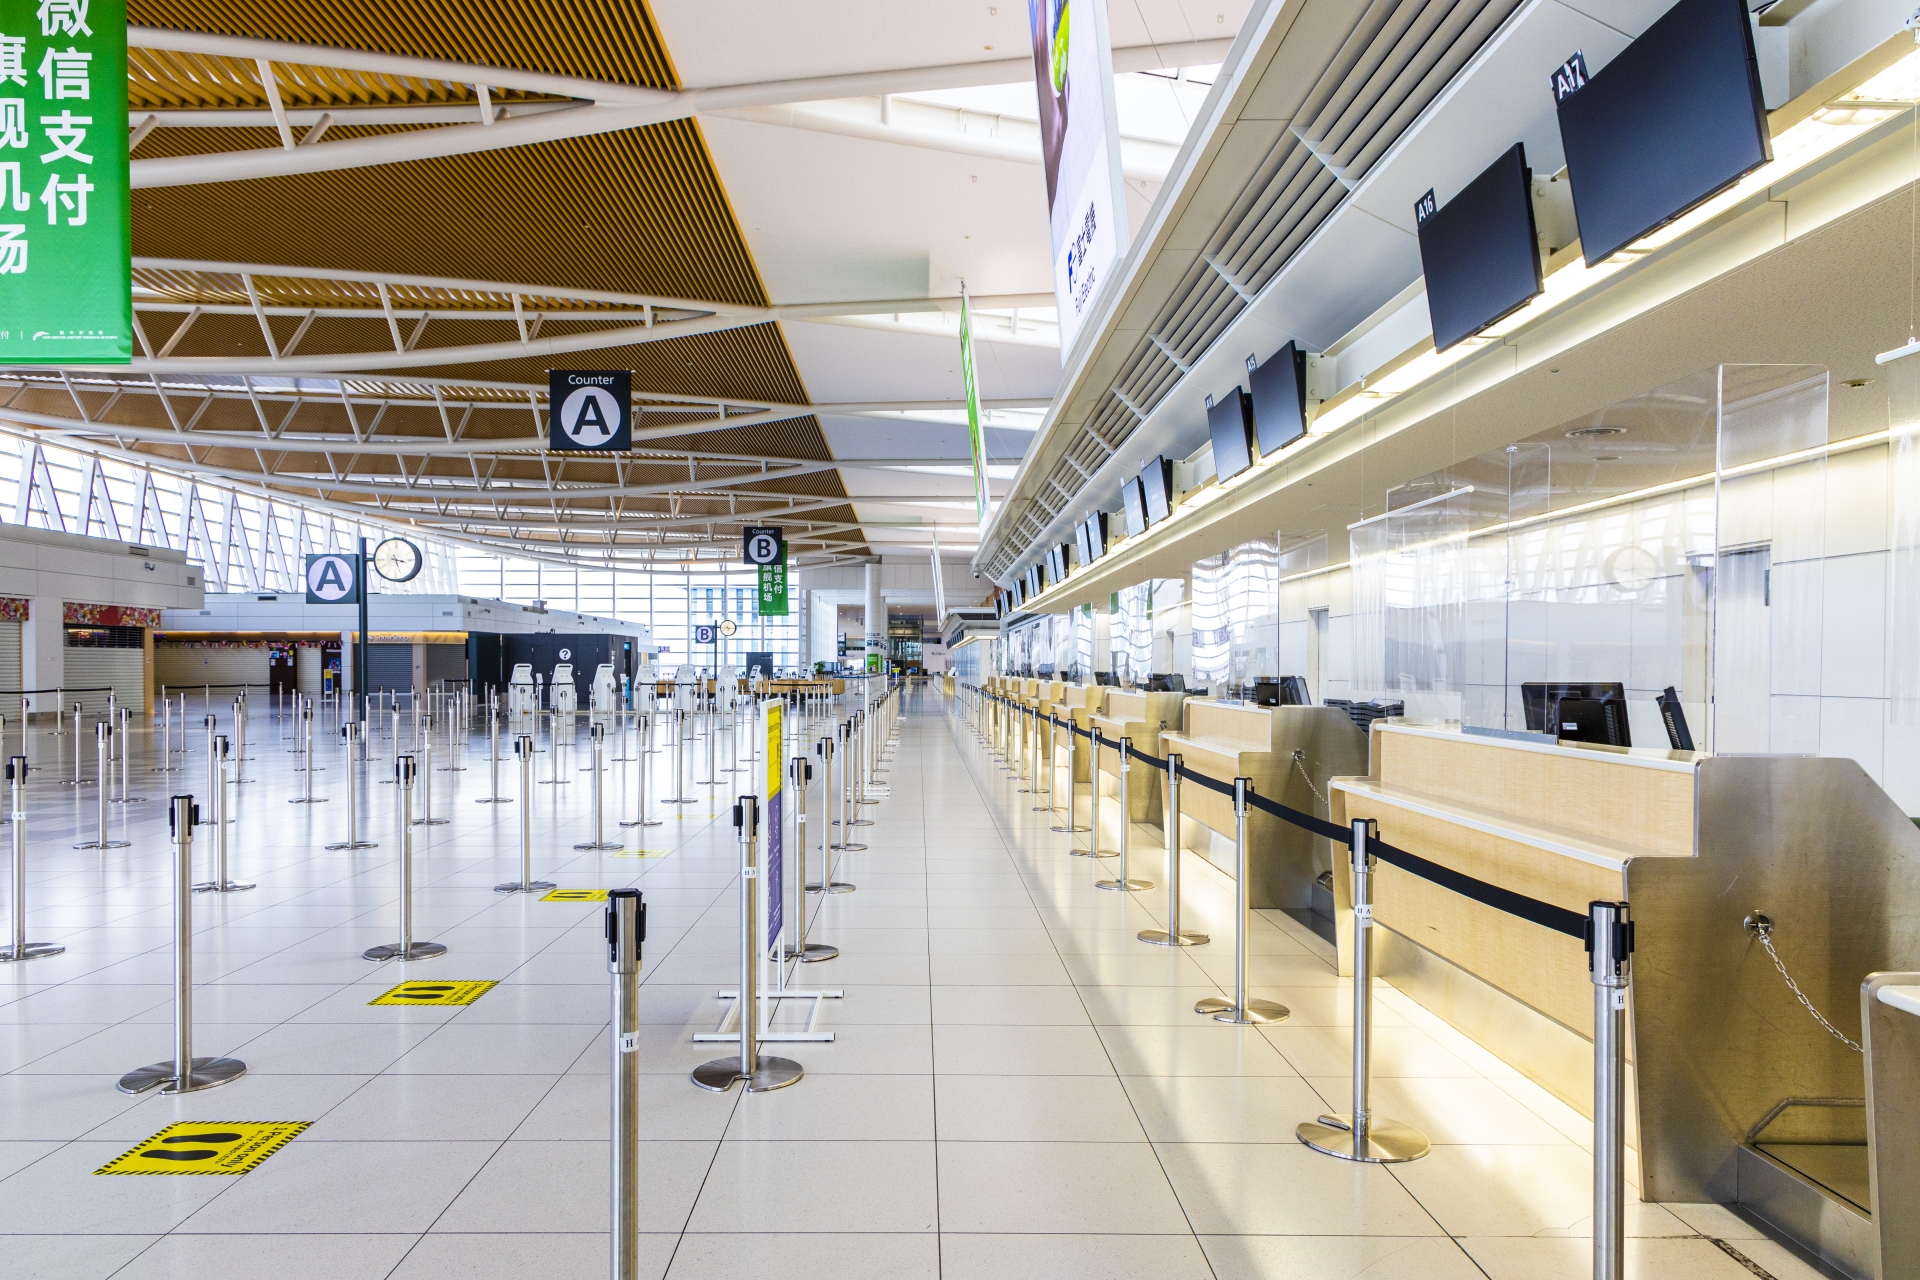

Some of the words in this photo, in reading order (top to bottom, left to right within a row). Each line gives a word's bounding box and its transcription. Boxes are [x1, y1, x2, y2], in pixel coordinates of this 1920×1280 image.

[1558, 58, 1582, 99] A17
[1418, 194, 1434, 223] A16
[568, 374, 615, 385] Counter
[571, 395, 611, 436] A
[757, 538, 771, 558] B
[315, 560, 347, 592] A
[700, 628, 709, 641] B
[1617, 994, 1624, 1005] H
[625, 1038, 633, 1048] H
[243, 1131, 283, 1153] Person
[220, 1153, 249, 1168] only
